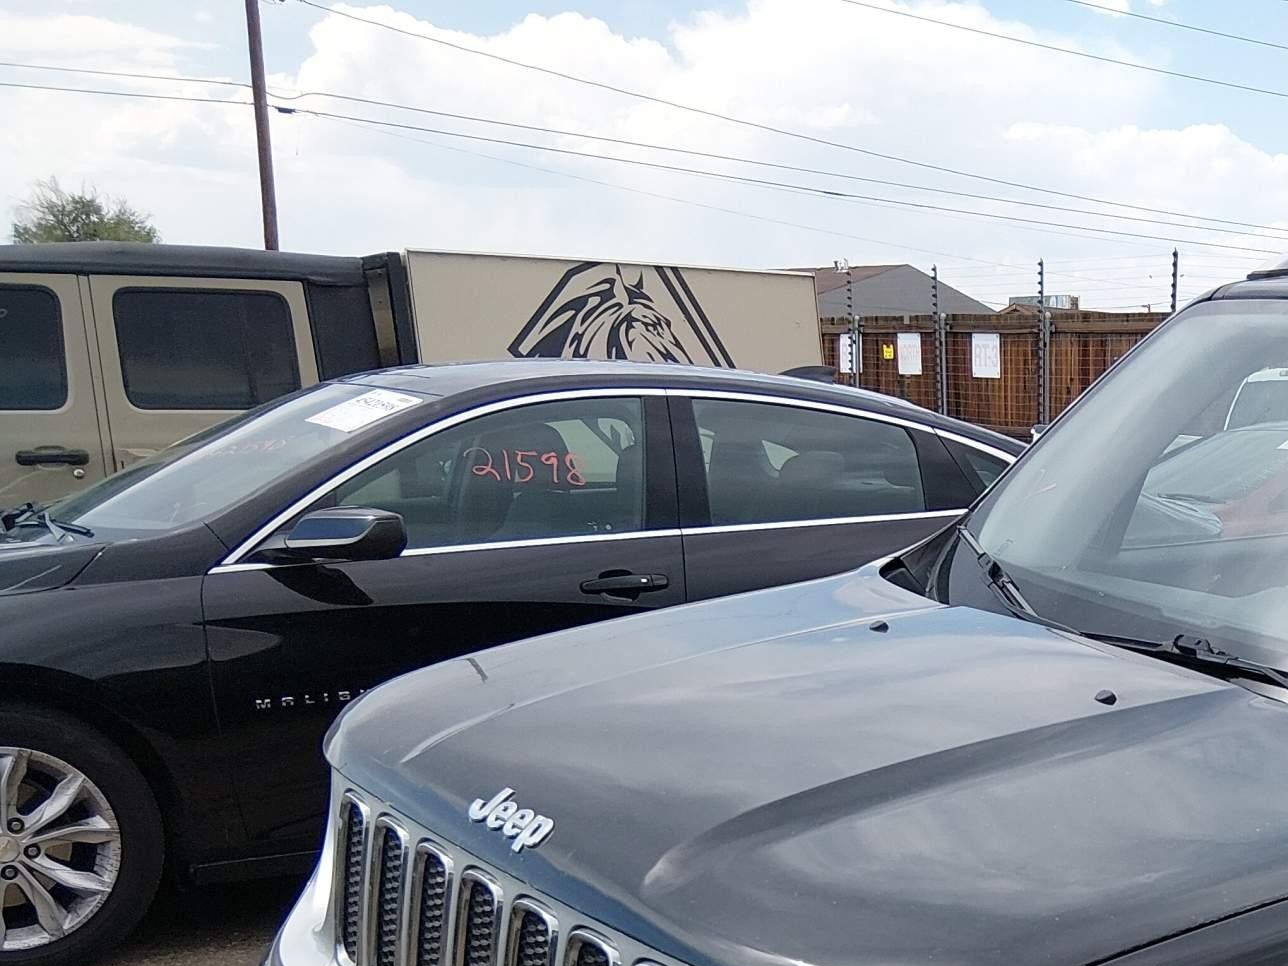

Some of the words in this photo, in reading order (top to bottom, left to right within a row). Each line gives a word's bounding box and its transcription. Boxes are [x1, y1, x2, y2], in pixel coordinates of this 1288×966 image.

[463, 447, 587, 486] 21598
[255, 688, 366, 709] MALIB
[468, 786, 555, 854] Jeep
